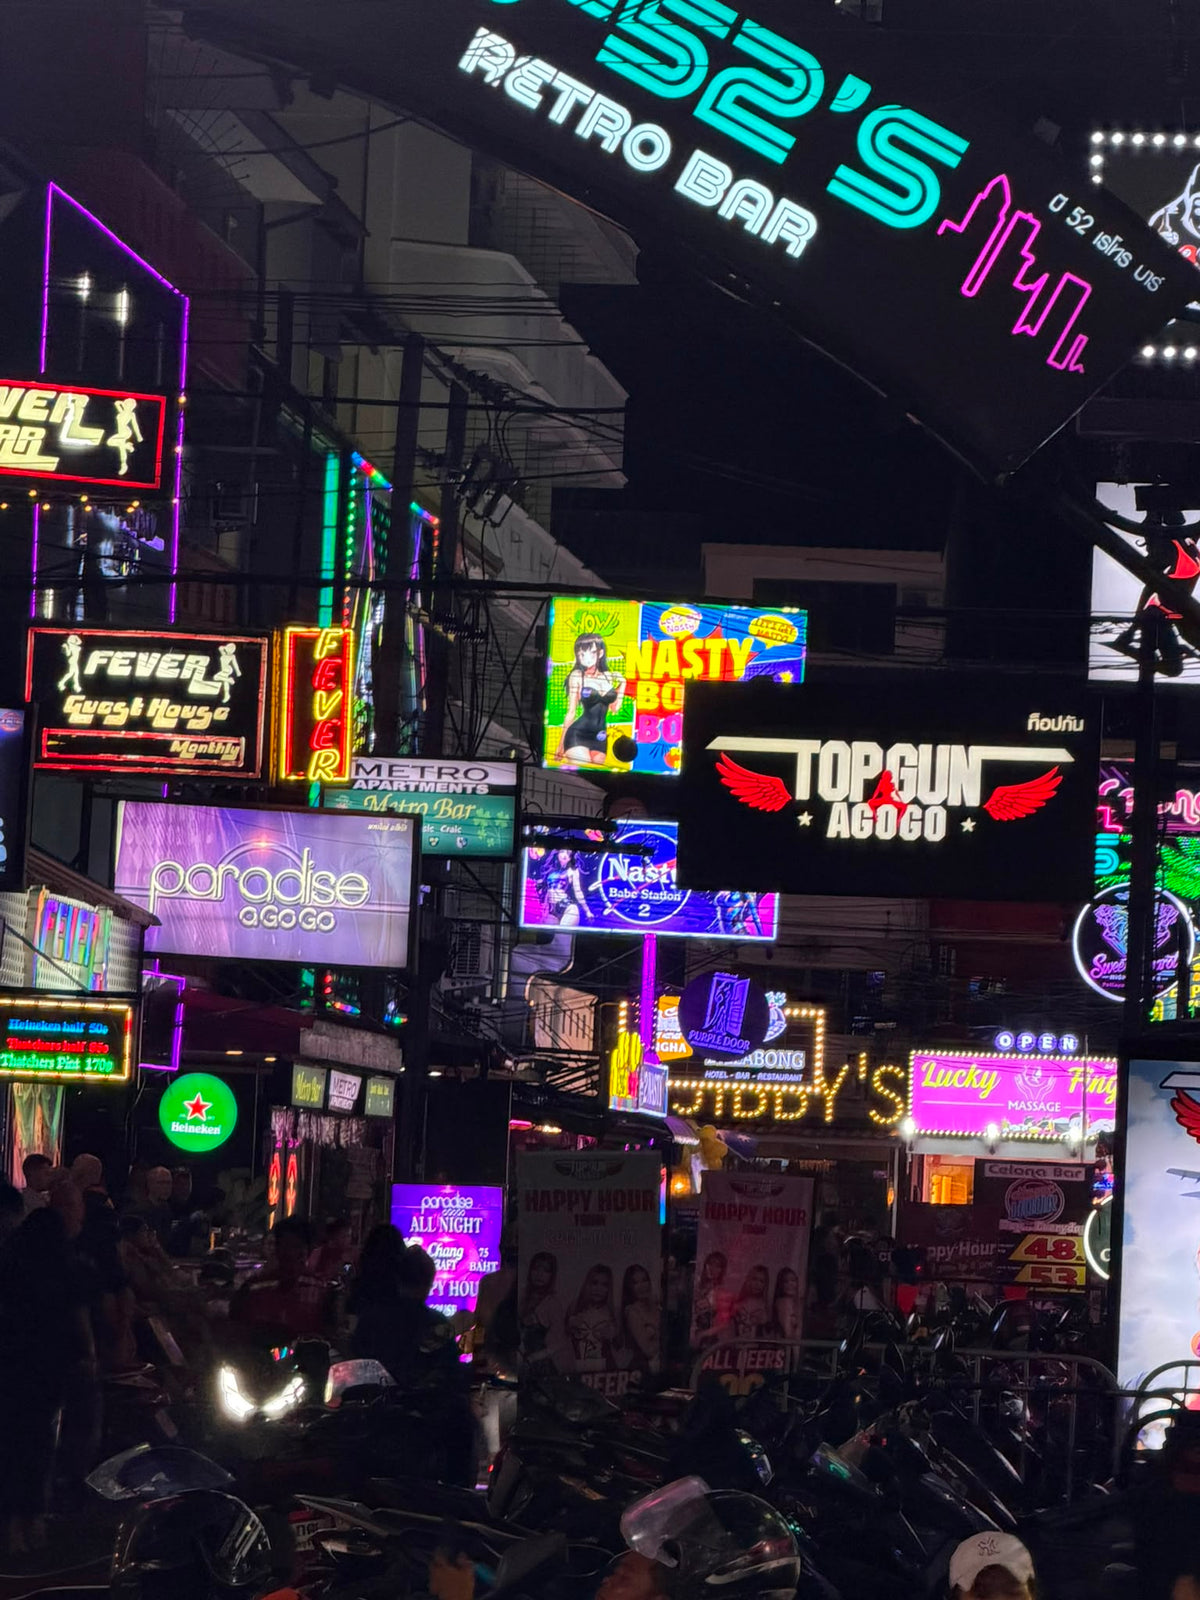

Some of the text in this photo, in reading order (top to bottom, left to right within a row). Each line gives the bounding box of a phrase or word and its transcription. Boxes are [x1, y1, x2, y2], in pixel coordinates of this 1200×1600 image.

[490, 0, 971, 229] 52'S
[458, 26, 818, 259] RETRO BAR
[1065, 206, 1095, 235] 52
[625, 637, 755, 682] NASTY
[84, 651, 222, 695] FEVER
[63, 695, 231, 730] Guest House
[309, 628, 346, 783] FEVER
[1027, 711, 1084, 732] ท็อปกัน
[169, 740, 241, 761] Monthly
[355, 762, 490, 782] METRO
[352, 779, 489, 795] APARTMENTS
[432, 797, 477, 820] Bar
[150, 848, 371, 914] paradise
[608, 887, 682, 901] Babe Station
[637, 903, 651, 917] 2
[7, 1018, 61, 1032] Heineken
[687, 1029, 723, 1046] PURPLE
[722, 1035, 751, 1051] DOOR
[998, 1033, 1076, 1051] OPEN
[56, 1055, 81, 1070] Pint
[704, 1070, 803, 1082] HOTEL BAR RESTAURANT
[920, 1060, 1001, 1100] Lucky
[333, 1077, 358, 1098] METRO
[1007, 1100, 1062, 1112] MASSAGE
[171, 1121, 222, 1135] Heineken
[988, 1163, 1083, 1179] Celona Bar
[420, 1190, 474, 1214] paradise
[525, 1188, 656, 1212] HAPPY HOUR
[408, 1215, 483, 1234] ALL NIGHT
[705, 1201, 807, 1227] HAPPY HOUR
[427, 1242, 490, 1262] Chang 75
[926, 1244, 956, 1262] ppy
[957, 1241, 996, 1257] Hour
[434, 1259, 499, 1272] RAFT BAHT
[1029, 1266, 1079, 1286] 53
[428, 1280, 480, 1297] PY HOU
[702, 1350, 735, 1370] ALL
